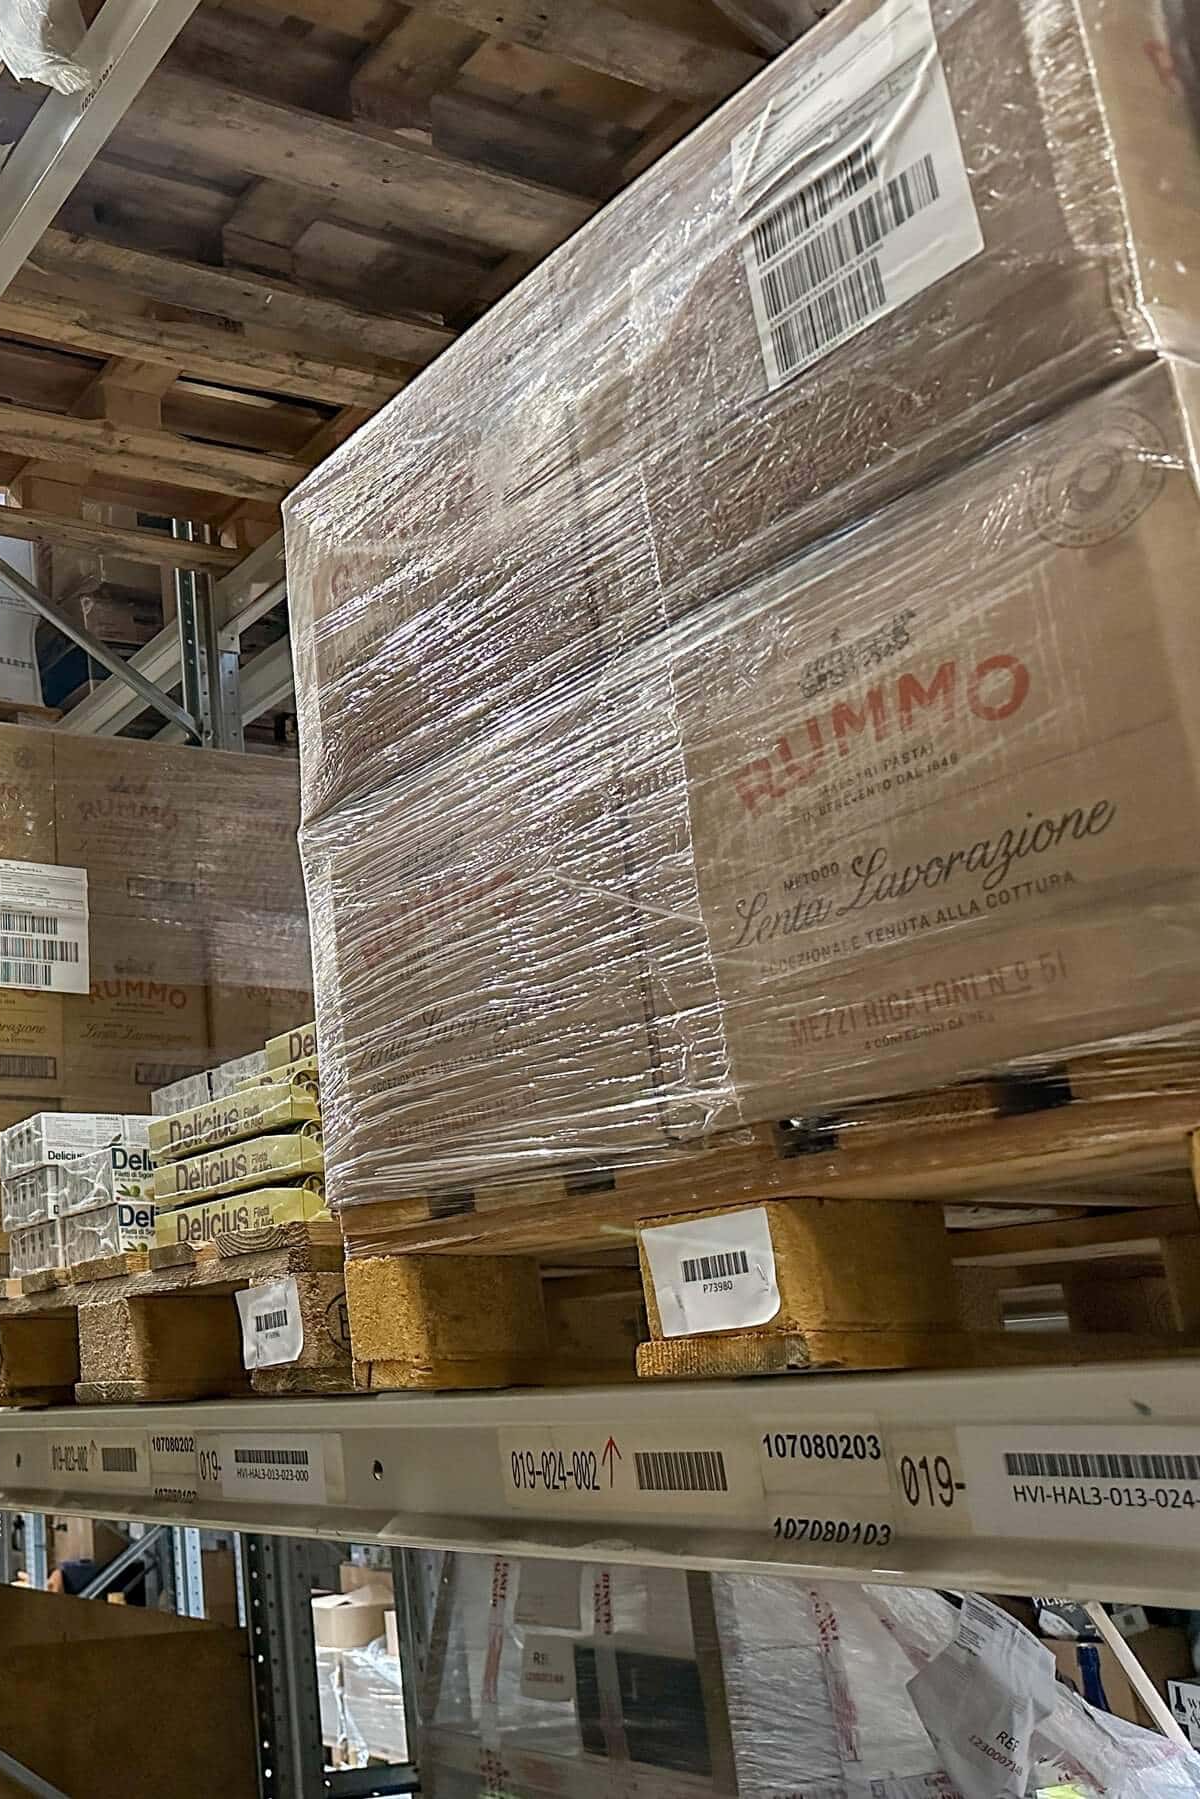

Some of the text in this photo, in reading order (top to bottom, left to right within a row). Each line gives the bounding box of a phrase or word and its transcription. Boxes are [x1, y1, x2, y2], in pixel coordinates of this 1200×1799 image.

[734, 653, 1031, 819] RUMMO
[734, 800, 1117, 950] Lenta Lavorazione
[781, 861, 840, 893] METODO
[864, 914, 931, 944] TENUTA
[935, 900, 982, 929] ALLA
[985, 869, 1077, 910] COTTURA
[1040, 950, 1068, 985] 51
[89, 979, 188, 1010] RUMMO
[169, 1105, 240, 1153] Delicius
[175, 1150, 248, 1193] Delicius
[177, 1203, 250, 1248] Delicius
[703, 1280, 734, 1294] P73980
[152, 1436, 195, 1452] 107080202
[762, 1433, 882, 1460] 107080203
[200, 1450, 222, 1481] 019-
[236, 1467, 309, 1483] HVI-HAL3-013-023-000
[511, 1451, 601, 1491] 019-024-002
[900, 1455, 966, 1508] 019-
[773, 1517, 892, 1547] 107080103
